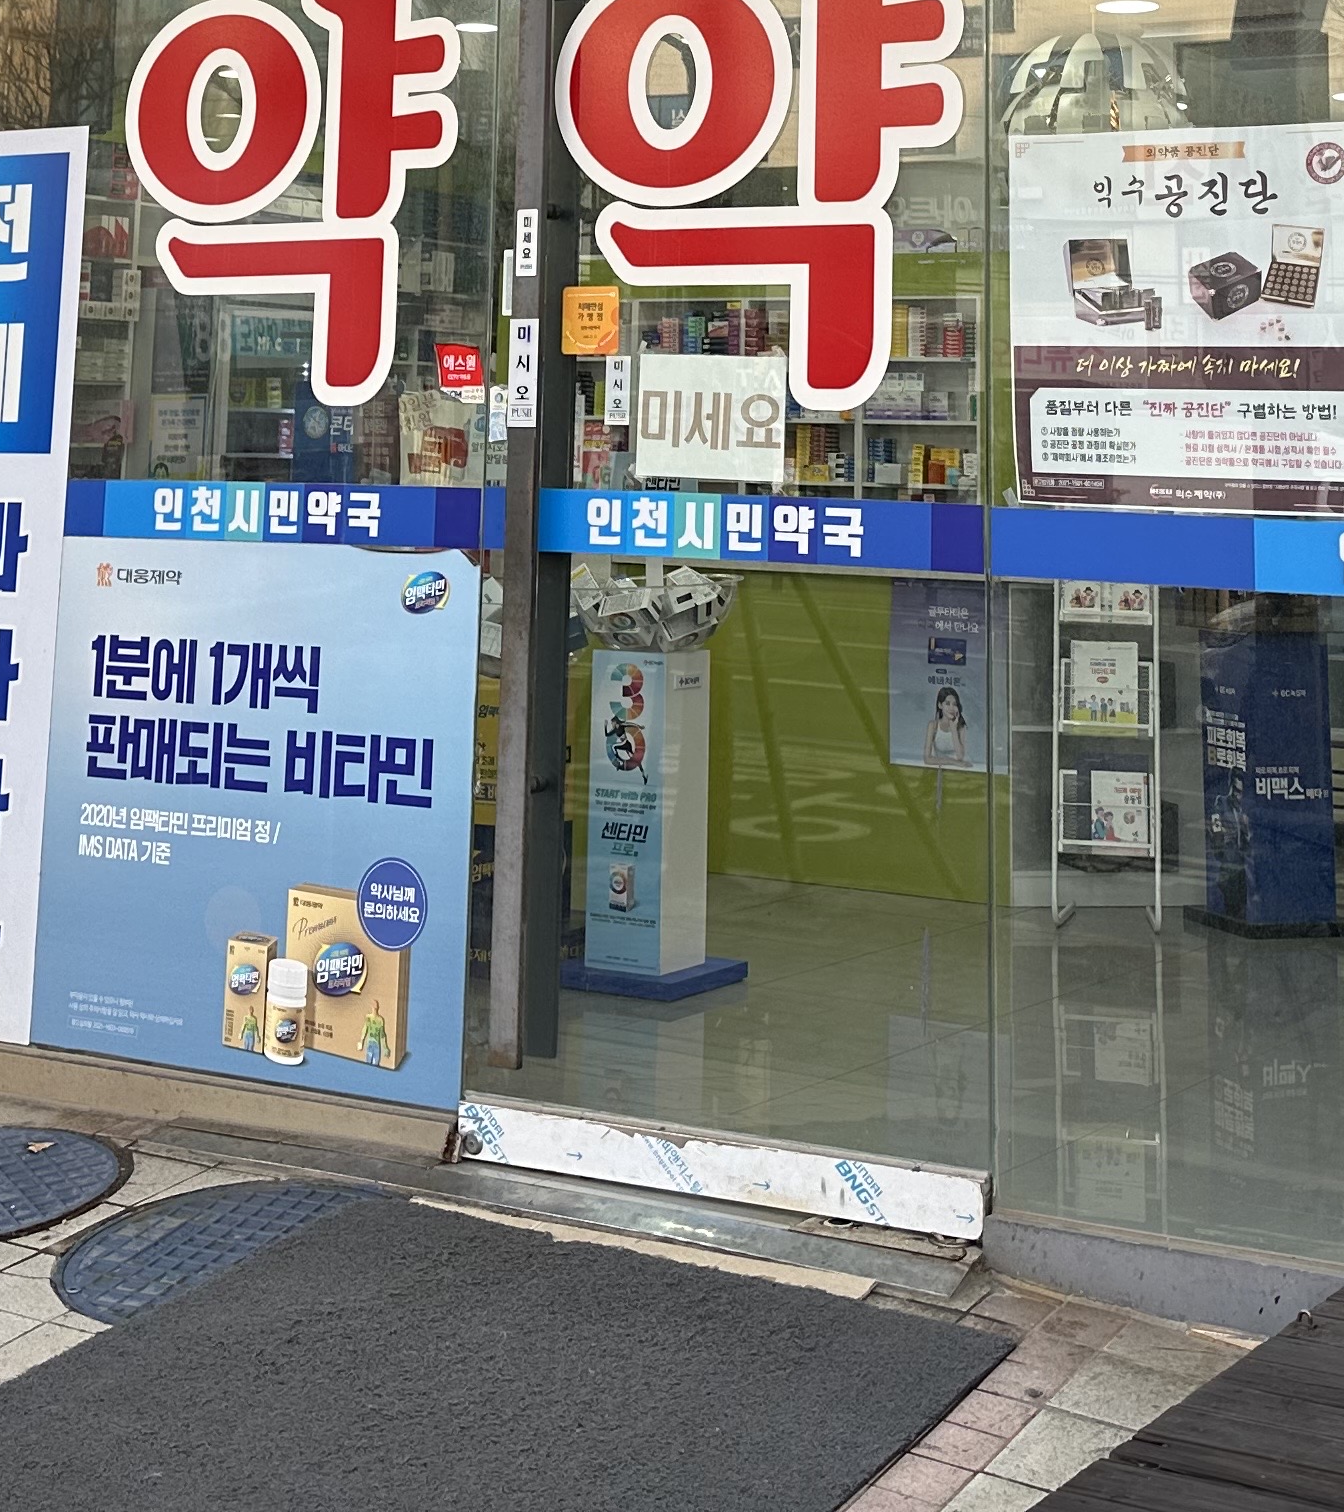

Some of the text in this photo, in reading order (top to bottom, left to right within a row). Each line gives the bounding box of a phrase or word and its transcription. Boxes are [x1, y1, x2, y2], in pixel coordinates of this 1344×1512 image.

[1145, 144, 1220, 159] 의약품 공진단
[522, 216, 532, 259] 미세요
[443, 353, 477, 372] 에스원
[516, 325, 531, 400] 미시오
[1076, 355, 1301, 379] 더 이상 가짜에 속지 마세요!
[612, 360, 623, 408] 미시오
[640, 390, 782, 451] 미세요
[1045, 400, 1099, 416] 품질부터
[1105, 400, 1133, 416] 다른
[1237, 403, 1297, 420] 구별하는
[1303, 403, 1337, 420] 방법!
[154, 486, 381, 537] 인천시민약국
[586, 497, 864, 558] 인천시민약국
[117, 568, 182, 586] 대웅제약
[404, 578, 446, 601] 임팩타민
[91, 634, 321, 714] 1분에 1개씩
[86, 714, 434, 809] 판매되는 비타민
[1255, 777, 1305, 800] 비맥스
[80, 803, 271, 844] 2020년 임팩타민 프리미엄 정
[601, 822, 648, 843] 센타민
[78, 834, 171, 865] IMS DATA 기준
[371, 883, 415, 903] 약사님께
[364, 902, 420, 923] 문의하세요
[316, 953, 364, 984] 임팩타민
[657, 1138, 703, 1194] 비앤지스틸
[851, 1160, 884, 1199] UNDAI
